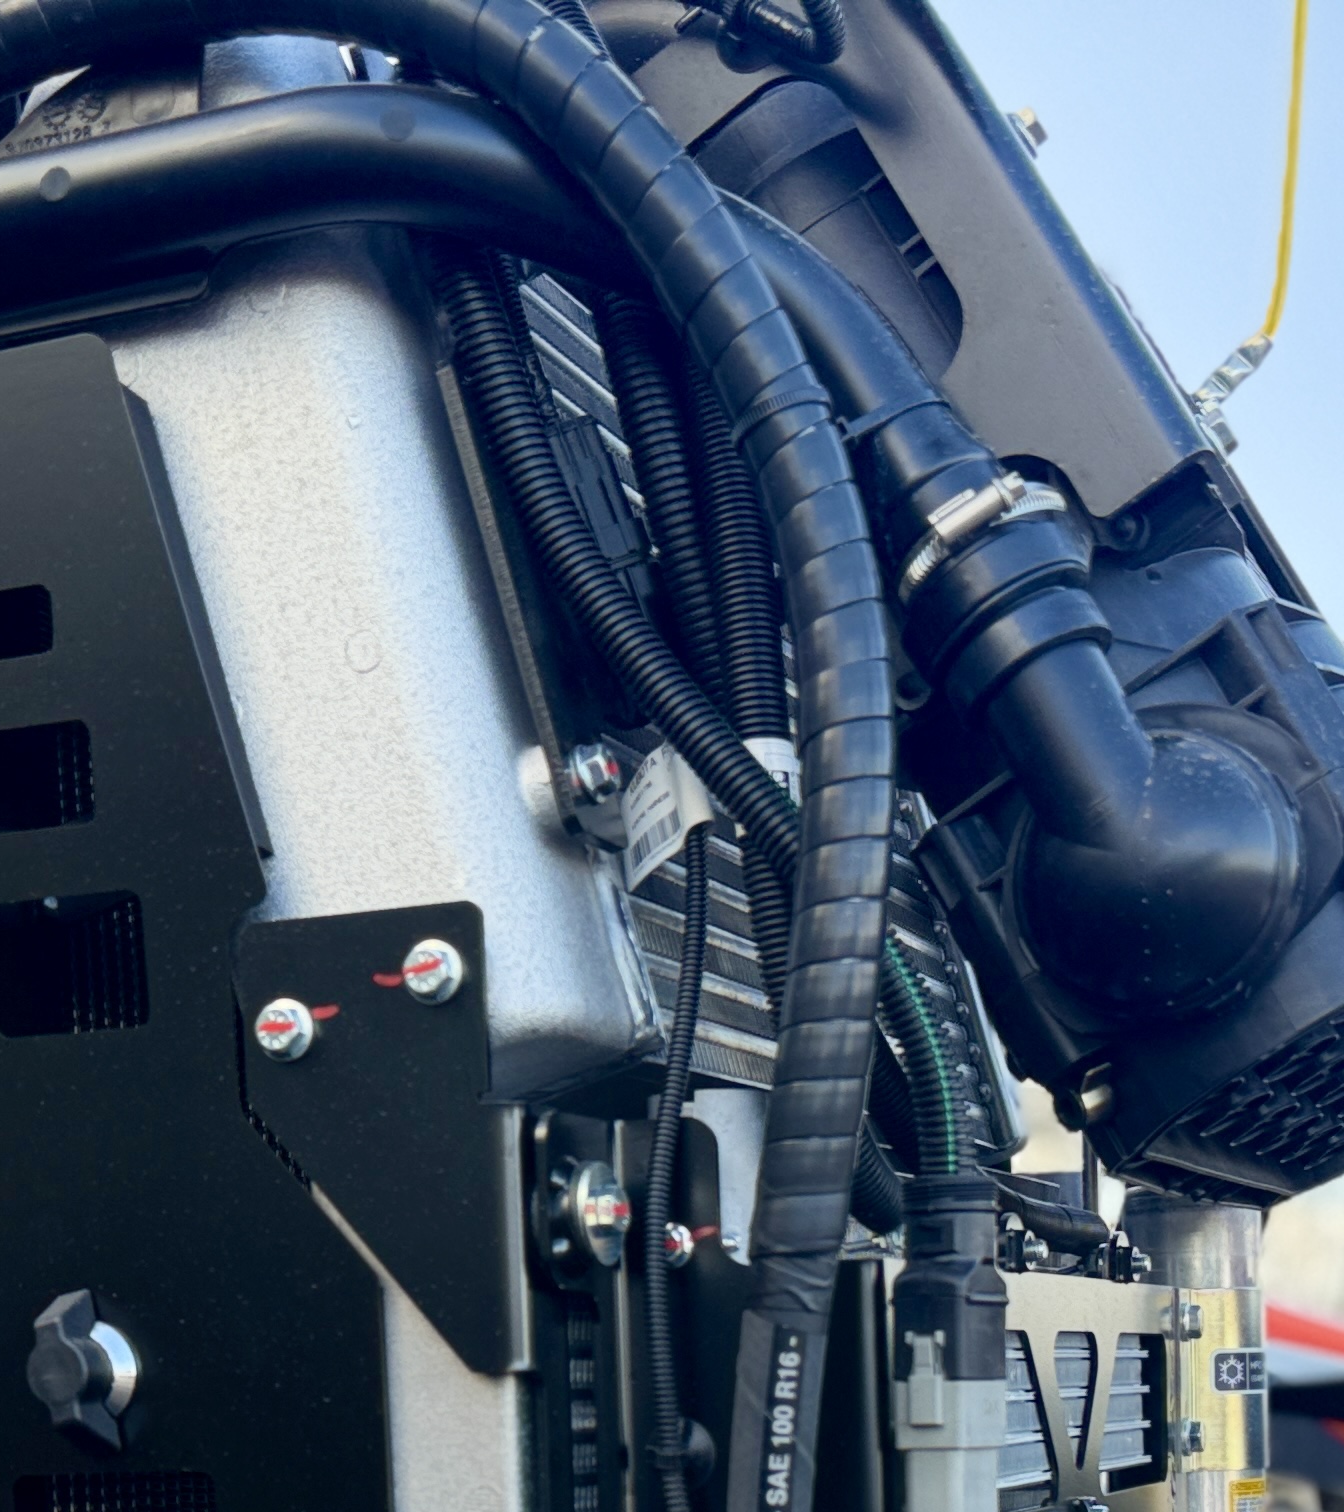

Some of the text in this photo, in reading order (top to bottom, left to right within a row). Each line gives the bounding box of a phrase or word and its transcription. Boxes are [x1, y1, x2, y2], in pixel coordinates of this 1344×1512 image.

[774, 1351, 801, 1399] R16
[771, 1404, 795, 1447] 100
[766, 1453, 792, 1506] SAE
